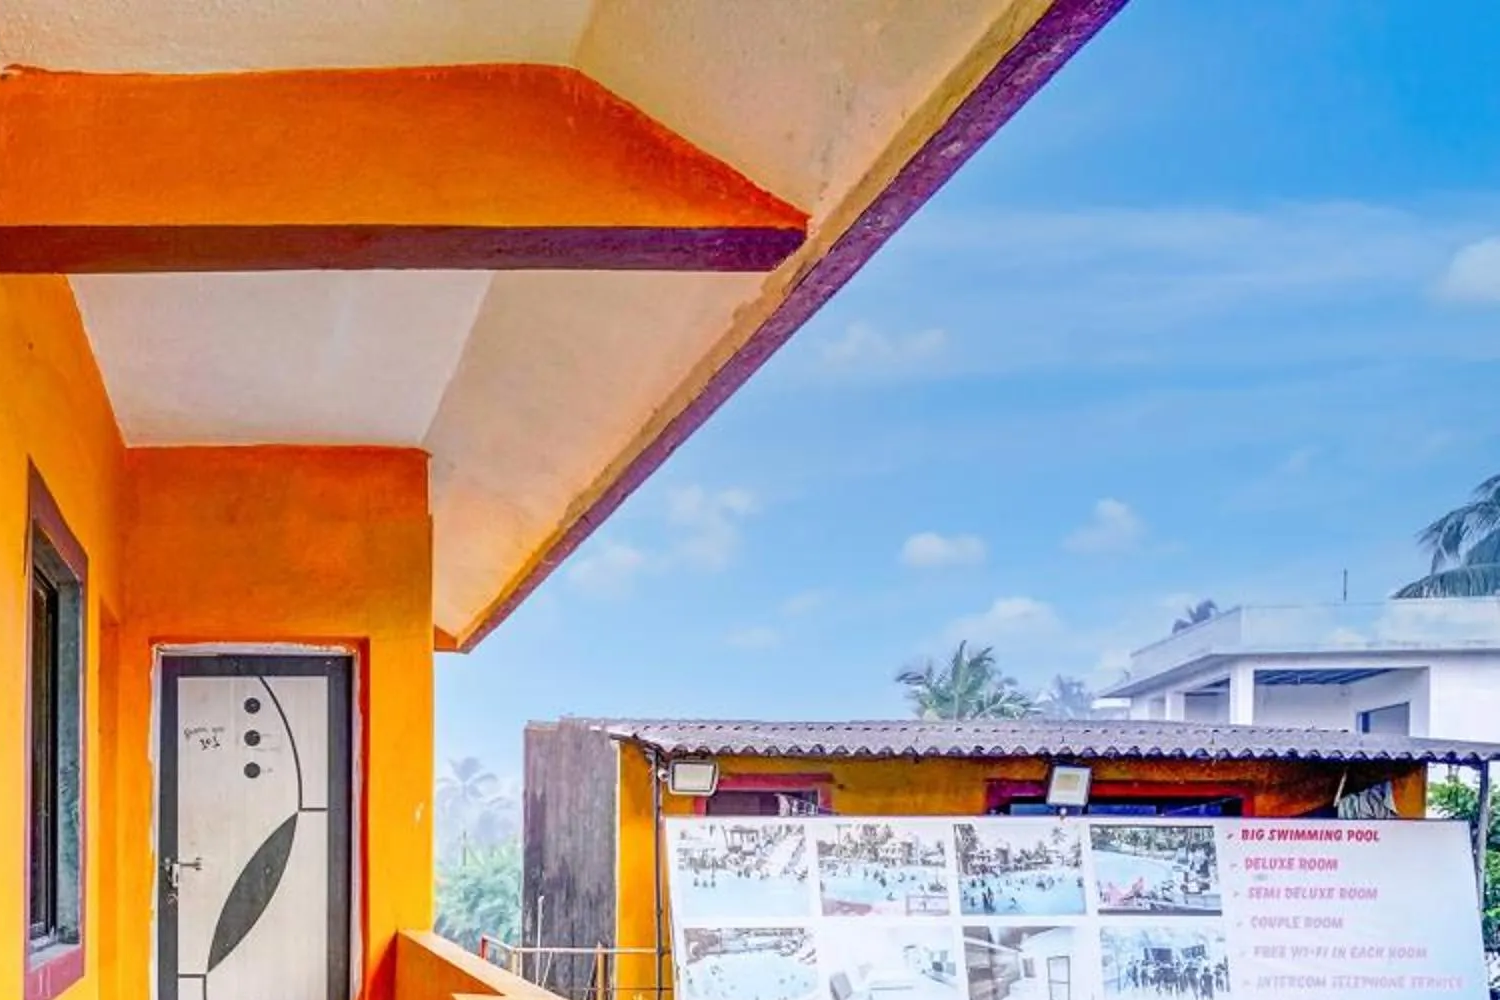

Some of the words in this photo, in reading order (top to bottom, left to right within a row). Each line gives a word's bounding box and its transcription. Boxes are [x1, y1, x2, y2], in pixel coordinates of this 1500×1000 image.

[1241, 829, 1265, 841] BIG
[1268, 829, 1343, 841] SWIMMING
[1347, 829, 1380, 842] POOL
[1245, 857, 1295, 871] DELUXE
[1299, 858, 1339, 871] ROOM
[1248, 887, 1280, 899] SEMI
[1285, 887, 1334, 899] DELUXE
[1339, 887, 1379, 899] ROOM
[1250, 916, 1300, 929] COUPLE
[1304, 916, 1344, 929] ROOM
[1254, 945, 1286, 958] FREE
[1331, 946, 1347, 959] IN
[1350, 946, 1384, 959] EACH
[1388, 947, 1427, 959] ROOM
[1257, 975, 1327, 989] INTERCOM
